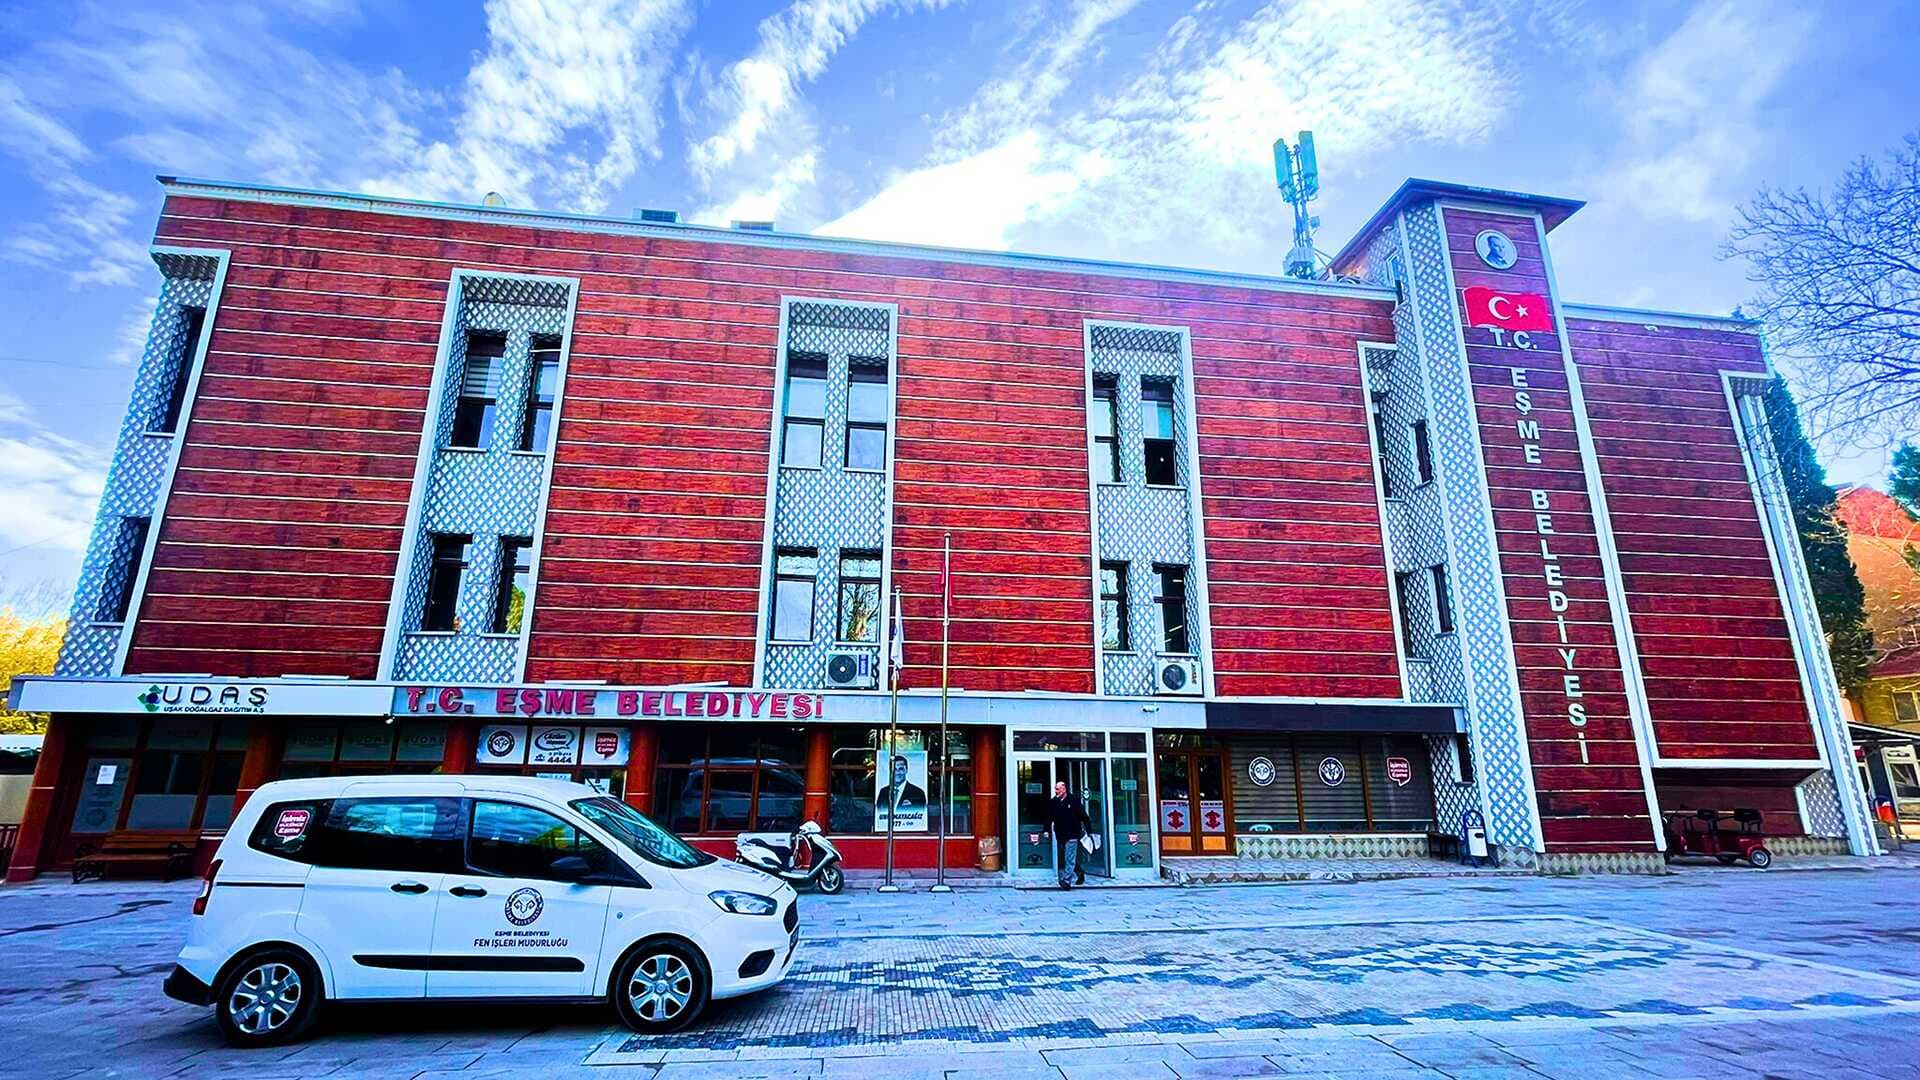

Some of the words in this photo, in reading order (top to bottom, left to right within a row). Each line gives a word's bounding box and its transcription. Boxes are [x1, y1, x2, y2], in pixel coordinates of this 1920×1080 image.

[1489, 326, 1538, 350] T.C.
[1510, 366, 1543, 464] EŞME
[1529, 488, 1590, 764] BELEDİYESİ
[407, 687, 475, 713] T.C.
[495, 688, 598, 717] EŞME
[616, 690, 824, 719] BELEDİYESİ
[474, 939, 490, 947] FEN
